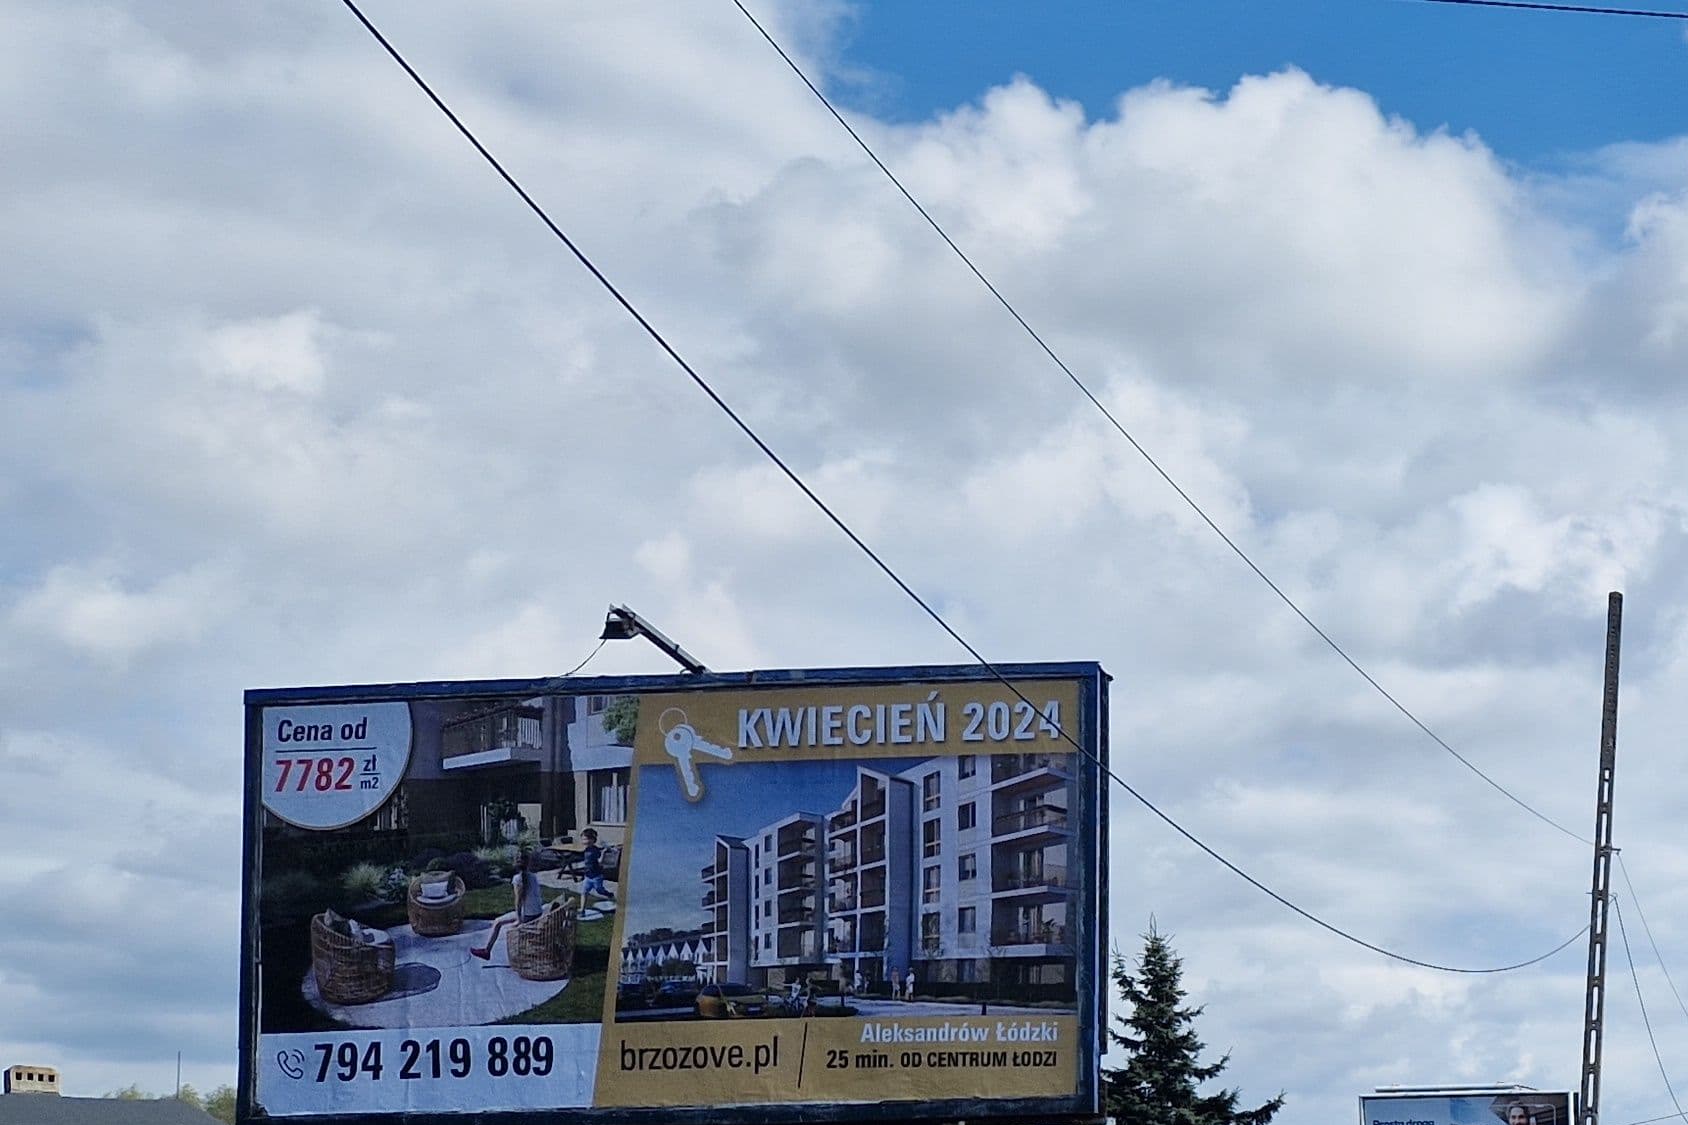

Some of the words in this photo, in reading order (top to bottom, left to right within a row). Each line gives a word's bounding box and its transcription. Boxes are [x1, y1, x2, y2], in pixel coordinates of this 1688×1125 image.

[276, 717, 332, 743] Cena
[340, 716, 368, 741] od
[737, 691, 947, 749] KWIECIEŃ
[961, 700, 1062, 743] 2024
[274, 757, 355, 792] 7782
[363, 755, 377, 772] zł
[360, 775, 380, 790] m2
[860, 1022, 989, 1044] Aleksandrów
[996, 1022, 1059, 1043] Łódzki
[314, 1041, 383, 1083] 794
[399, 1038, 471, 1079] 219
[487, 1035, 554, 1077] 889
[619, 1036, 779, 1075] brzozove.pl
[826, 1049, 850, 1069] 25
[855, 1049, 894, 1069] min.
[900, 1051, 922, 1068] OD
[926, 1050, 1007, 1068] CENTRUM
[1011, 1049, 1058, 1068] ŁODZI
